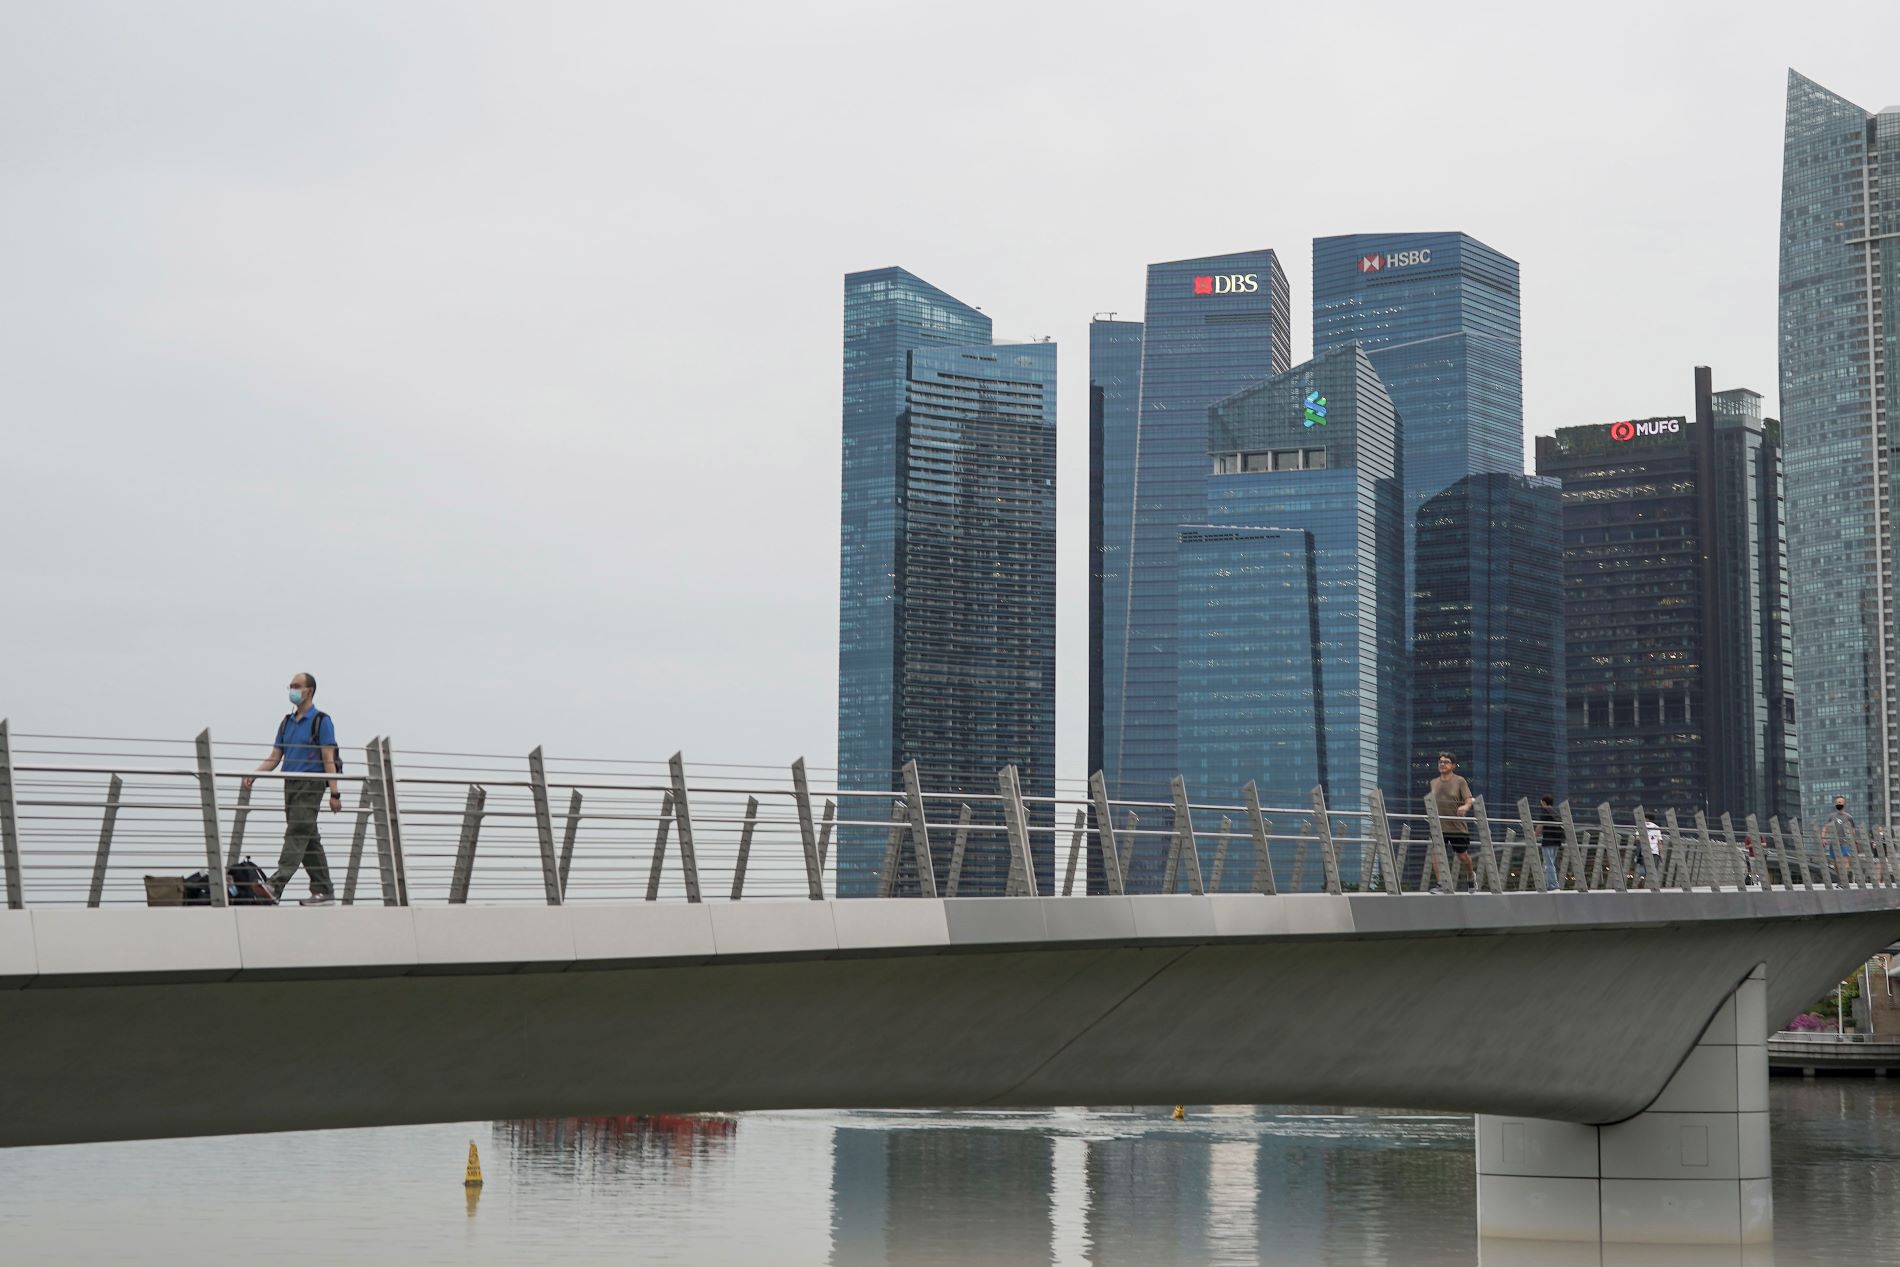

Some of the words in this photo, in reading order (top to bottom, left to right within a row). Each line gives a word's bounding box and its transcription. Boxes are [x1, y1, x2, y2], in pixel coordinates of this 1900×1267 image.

[1386, 249, 1431, 268] HSBC
[1215, 274, 1258, 294] DBS
[1636, 420, 1680, 436] MUFG
